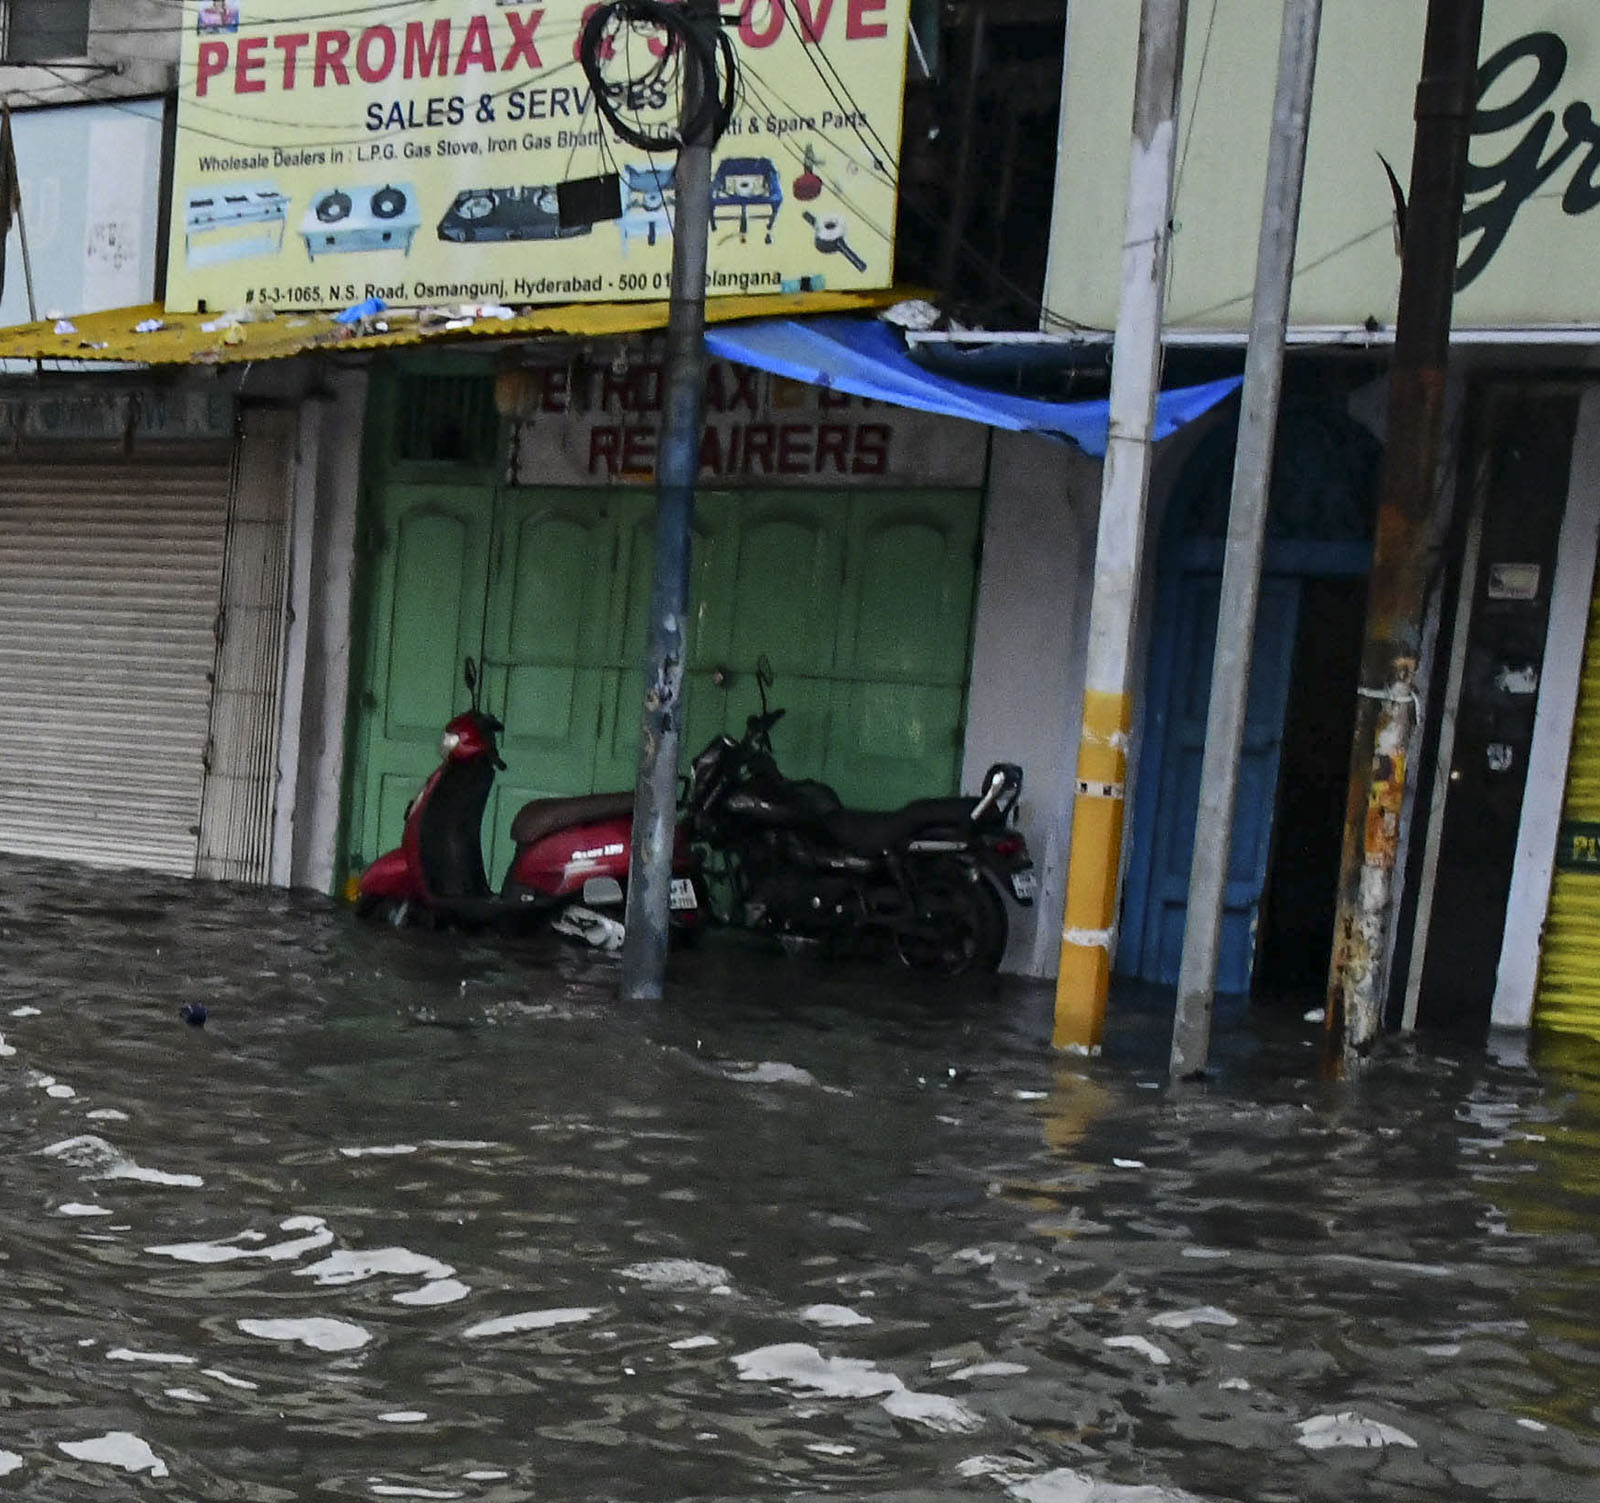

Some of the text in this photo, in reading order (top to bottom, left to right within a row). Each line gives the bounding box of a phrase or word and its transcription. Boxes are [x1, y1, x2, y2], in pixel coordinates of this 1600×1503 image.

[195, 9, 545, 97] PETROMAX
[366, 80, 667, 131] SALES & SERVCES
[199, 149, 269, 172] Wholesale
[273, 145, 326, 168] Dealers
[357, 142, 398, 162] L.P.G.
[404, 140, 432, 159] Gas
[437, 136, 483, 158] Stove,
[488, 133, 517, 152] Iron
[524, 132, 552, 150] Gas
[749, 114, 761, 134] &
[767, 110, 815, 138] Spare
[821, 109, 868, 131] Parts
[329, 284, 360, 301] N.S.
[364, 281, 409, 302] Road,
[414, 279, 509, 302] Osmangunj,
[514, 276, 601, 298] Hyderabad
[618, 273, 647, 290] 500
[590, 423, 895, 476] REAIRERS
